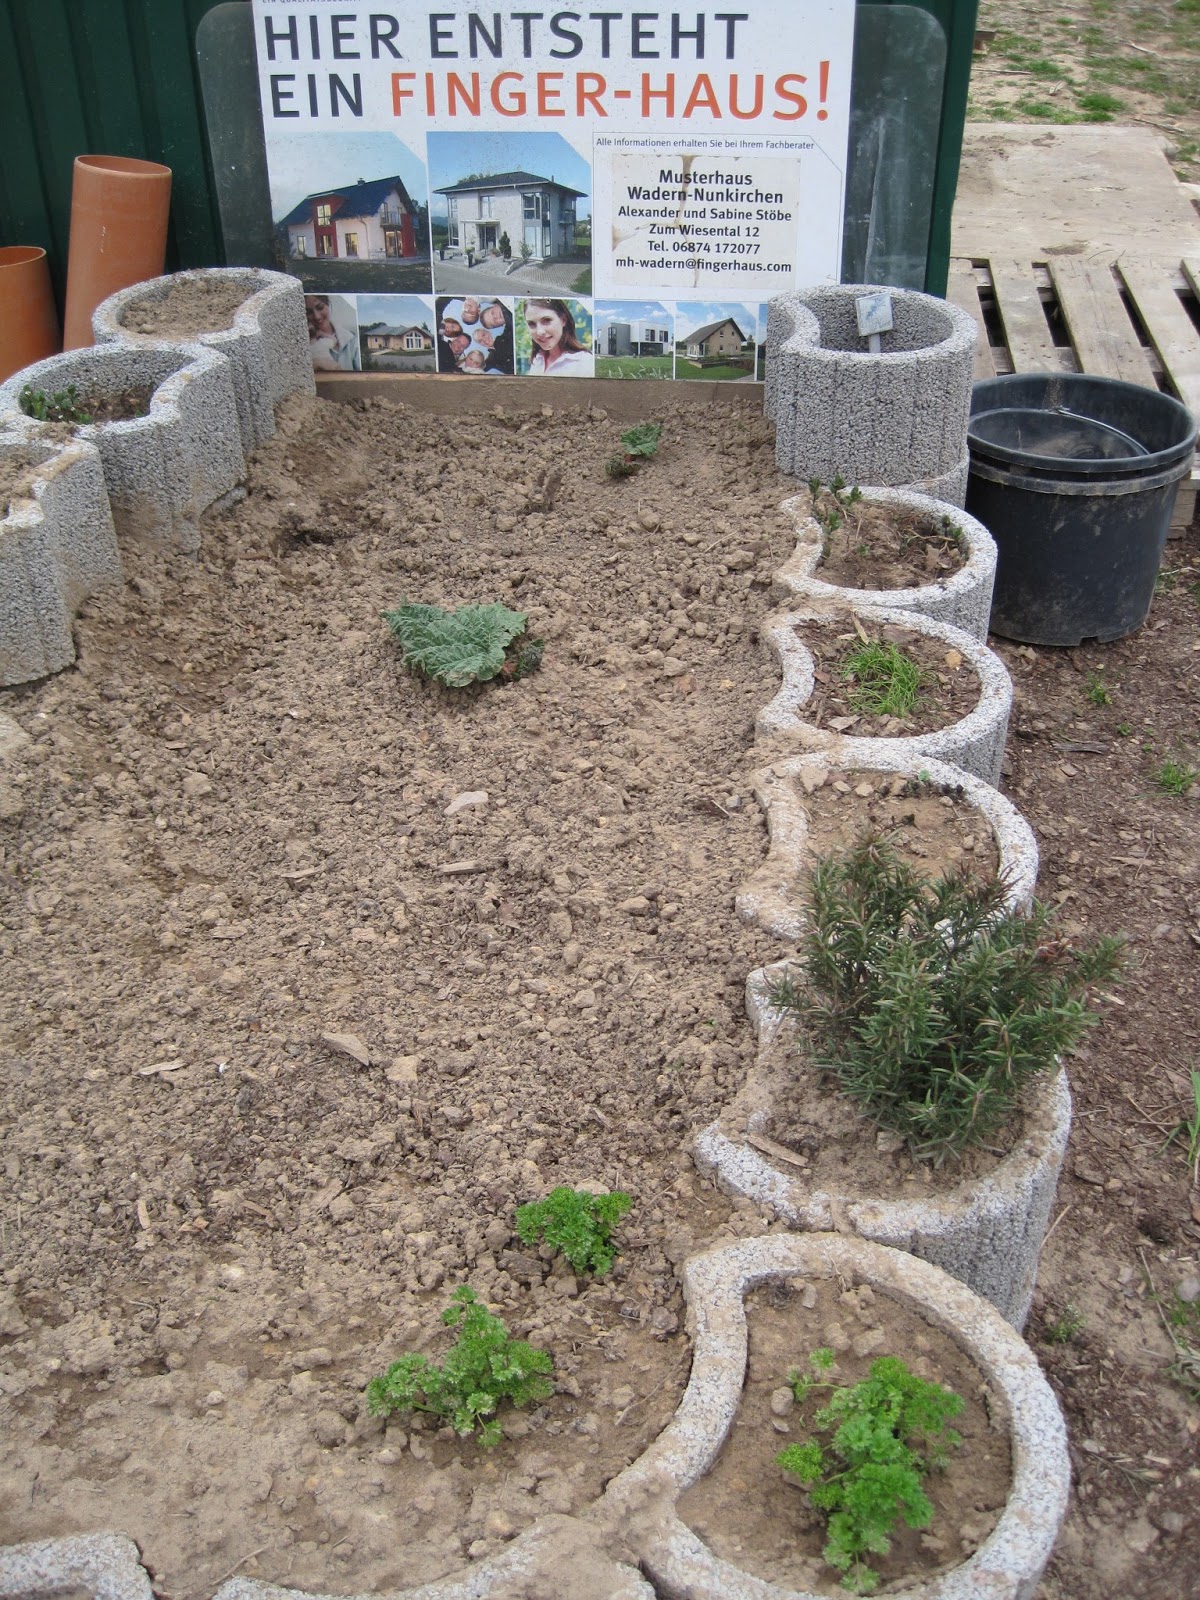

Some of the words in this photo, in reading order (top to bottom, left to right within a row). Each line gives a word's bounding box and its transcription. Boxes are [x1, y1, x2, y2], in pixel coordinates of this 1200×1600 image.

[264, 14, 403, 60] HIER
[428, 11, 749, 60] ENTSTEHT
[270, 73, 363, 118] EIN
[391, 60, 830, 121] FINGER-HAUS!
[596, 138, 612, 146] Alle
[614, 138, 671, 148] Informationen
[673, 139, 708, 148] erhalten
[710, 140, 722, 148] Sie
[725, 140, 738, 148] bei
[740, 140, 764, 149] Ihrem
[766, 141, 814, 150] Fachberater
[659, 170, 752, 186] Musterhaus
[628, 186, 784, 204] Wadern-Nunkirchen
[618, 206, 680, 218] Alexander
[684, 208, 706, 219] und
[710, 208, 752, 220] Sabine
[756, 210, 792, 221] Stöbe
[649, 224, 676, 235] Zum
[678, 224, 740, 236] Wiesental
[745, 227, 760, 237] 12
[648, 240, 668, 252] Tel.
[672, 242, 710, 253] 06874
[715, 244, 760, 254] 172077
[616, 257, 792, 272] mh-wadern@fingerhaus.com
